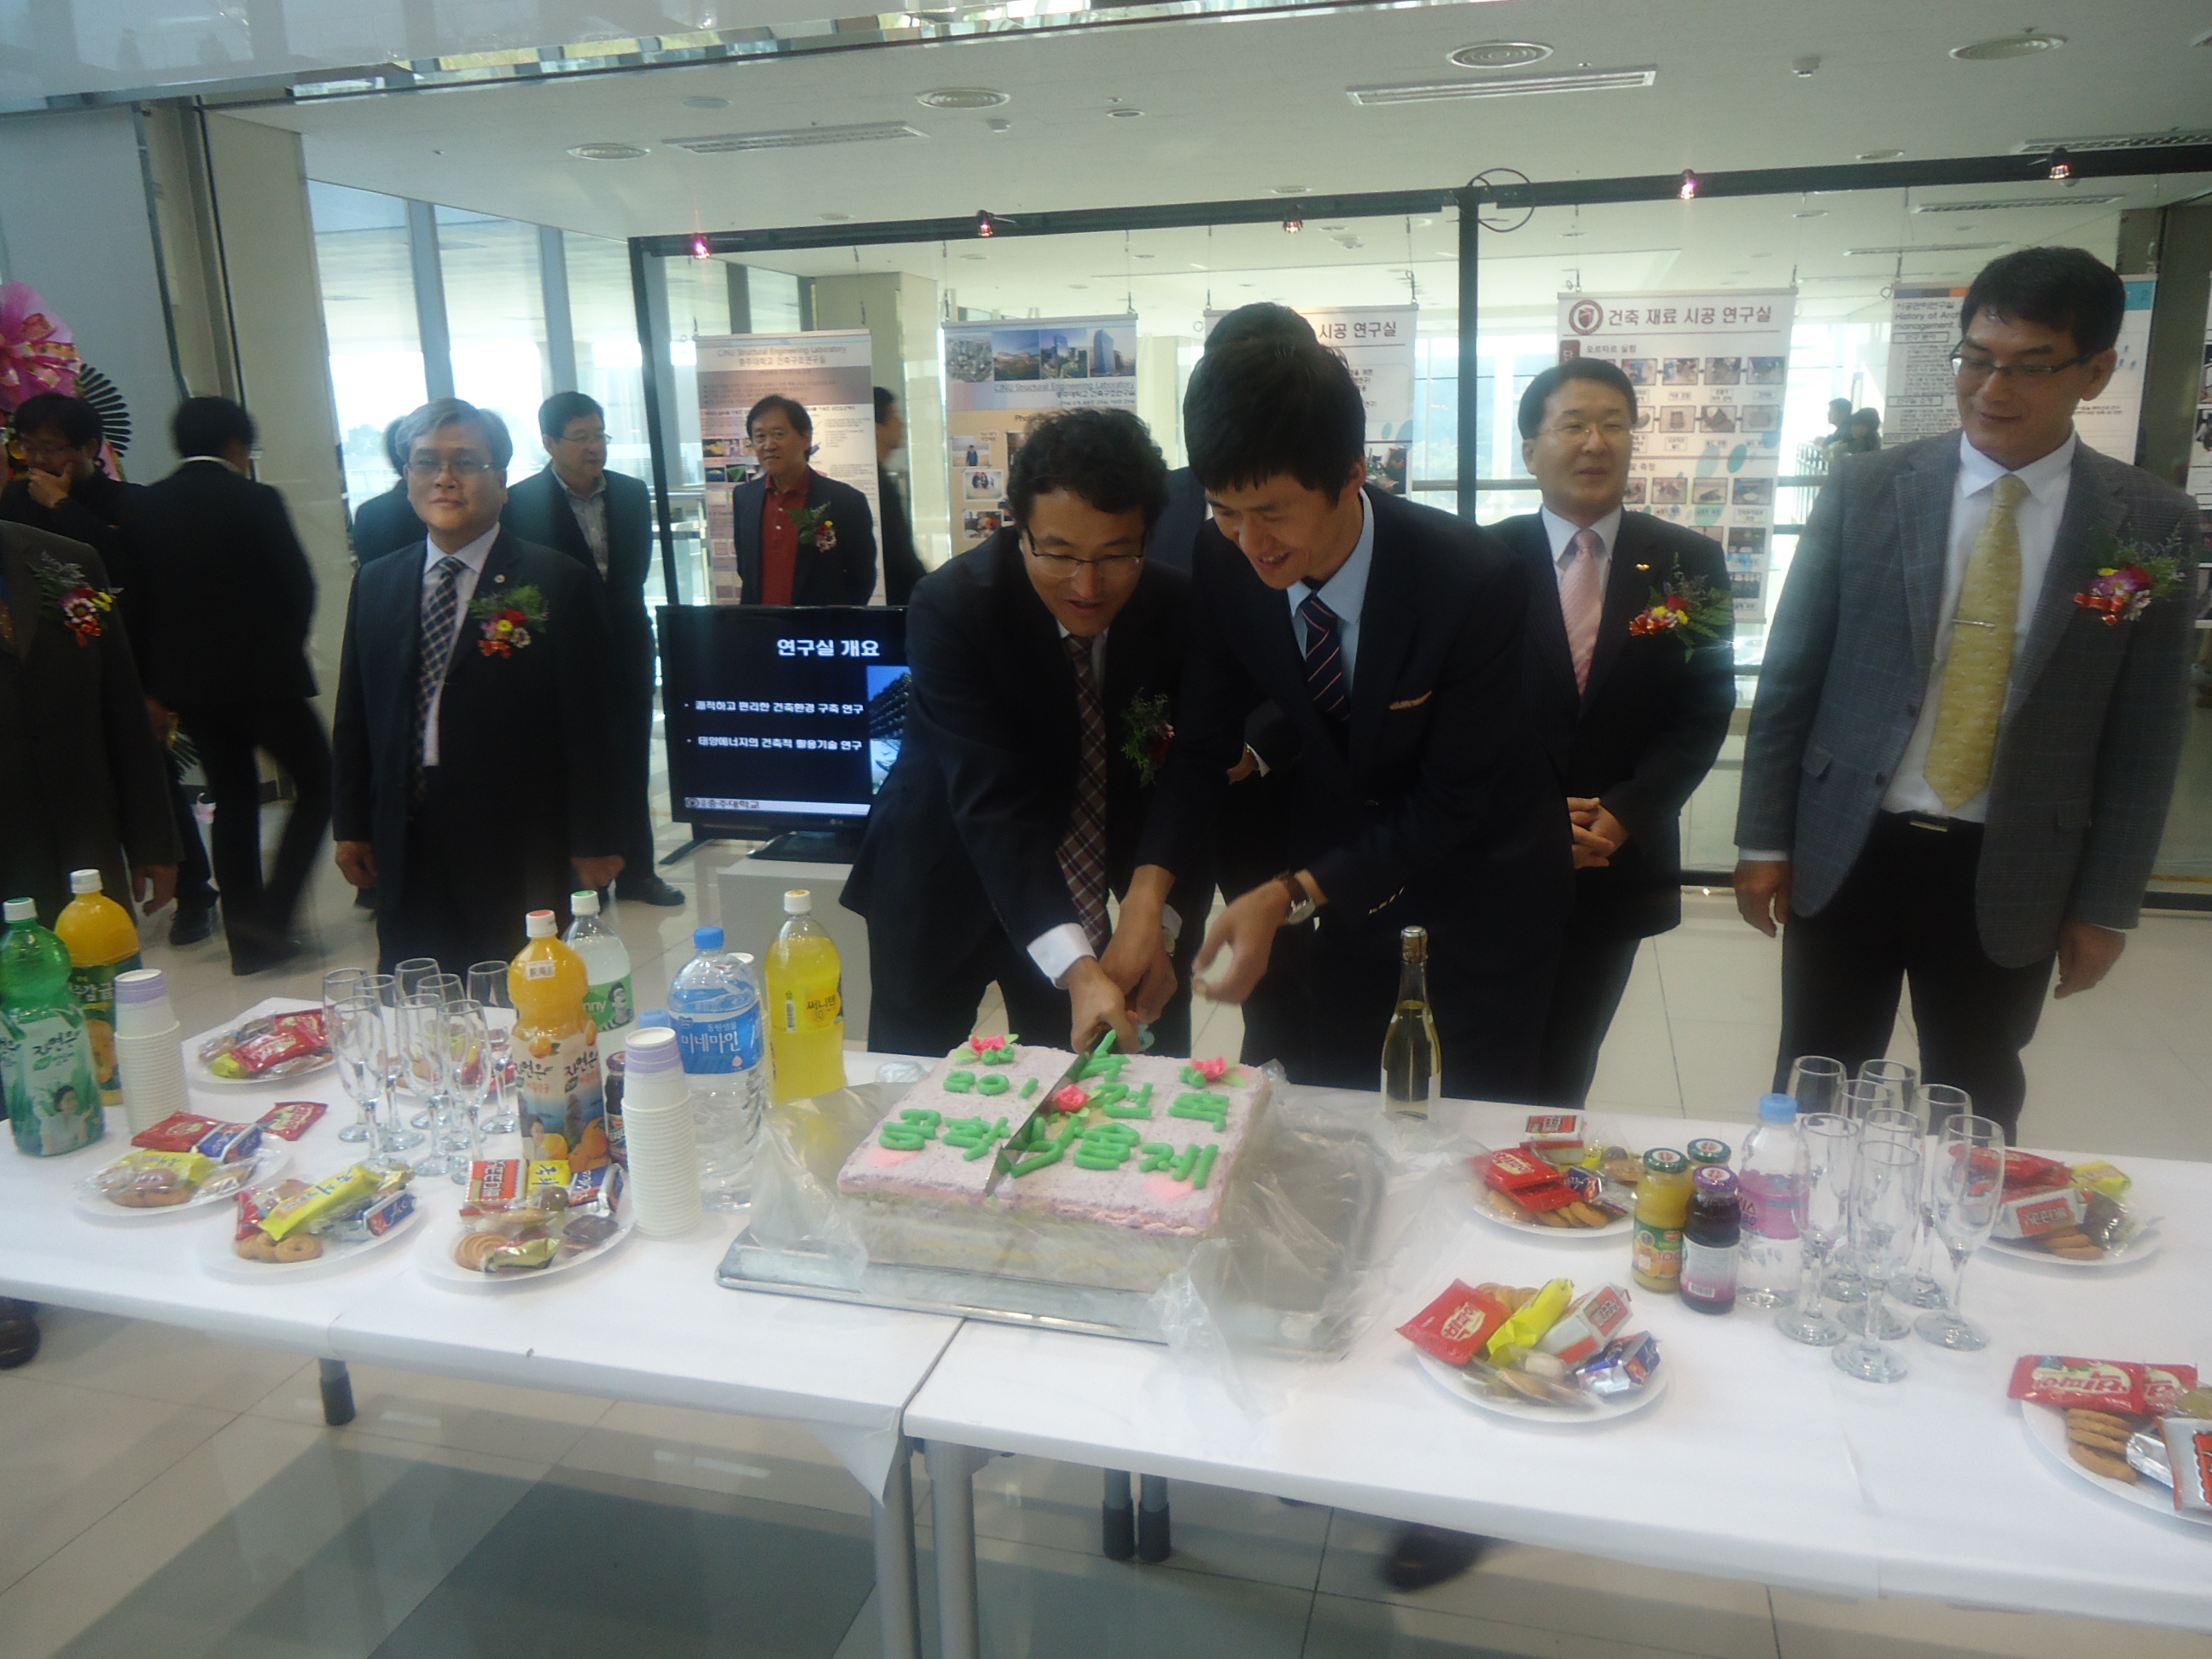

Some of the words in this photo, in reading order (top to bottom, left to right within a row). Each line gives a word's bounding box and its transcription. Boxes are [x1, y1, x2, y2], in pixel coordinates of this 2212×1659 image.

[1609, 308, 1639, 326] 건축
[1645, 308, 1677, 325] 재료
[1684, 306, 1715, 325] 시공
[1722, 306, 1773, 323] 연구실
[1318, 323, 1347, 340] 시공
[1353, 321, 1396, 339] 연구실
[737, 346, 767, 357] Structural
[770, 345, 809, 357] Engineering
[812, 345, 847, 354] Laboratory
[1051, 381, 1093, 393] Engineering
[1095, 381, 1135, 391] Laboratory
[777, 638, 835, 657] 연구실
[841, 639, 880, 657] 개요
[695, 700, 736, 712] 쾌적하고
[739, 701, 771, 713] 편리한
[772, 701, 815, 714] 건축환경
[818, 703, 839, 714] 구축
[841, 704, 864, 715] 연구
[698, 736, 759, 748] 태양에너지의
[761, 737, 793, 748] 건축적
[795, 738, 838, 750] 활용기술
[841, 741, 863, 751] 연구
[707, 799, 760, 810] 충주대학교
[582, 999, 607, 1014] nny
[806, 994, 836, 1010] 써니텐
[32, 1030, 79, 1056] 자연은
[681, 1031, 742, 1054] 미네마인
[564, 1051, 598, 1076] 자연은
